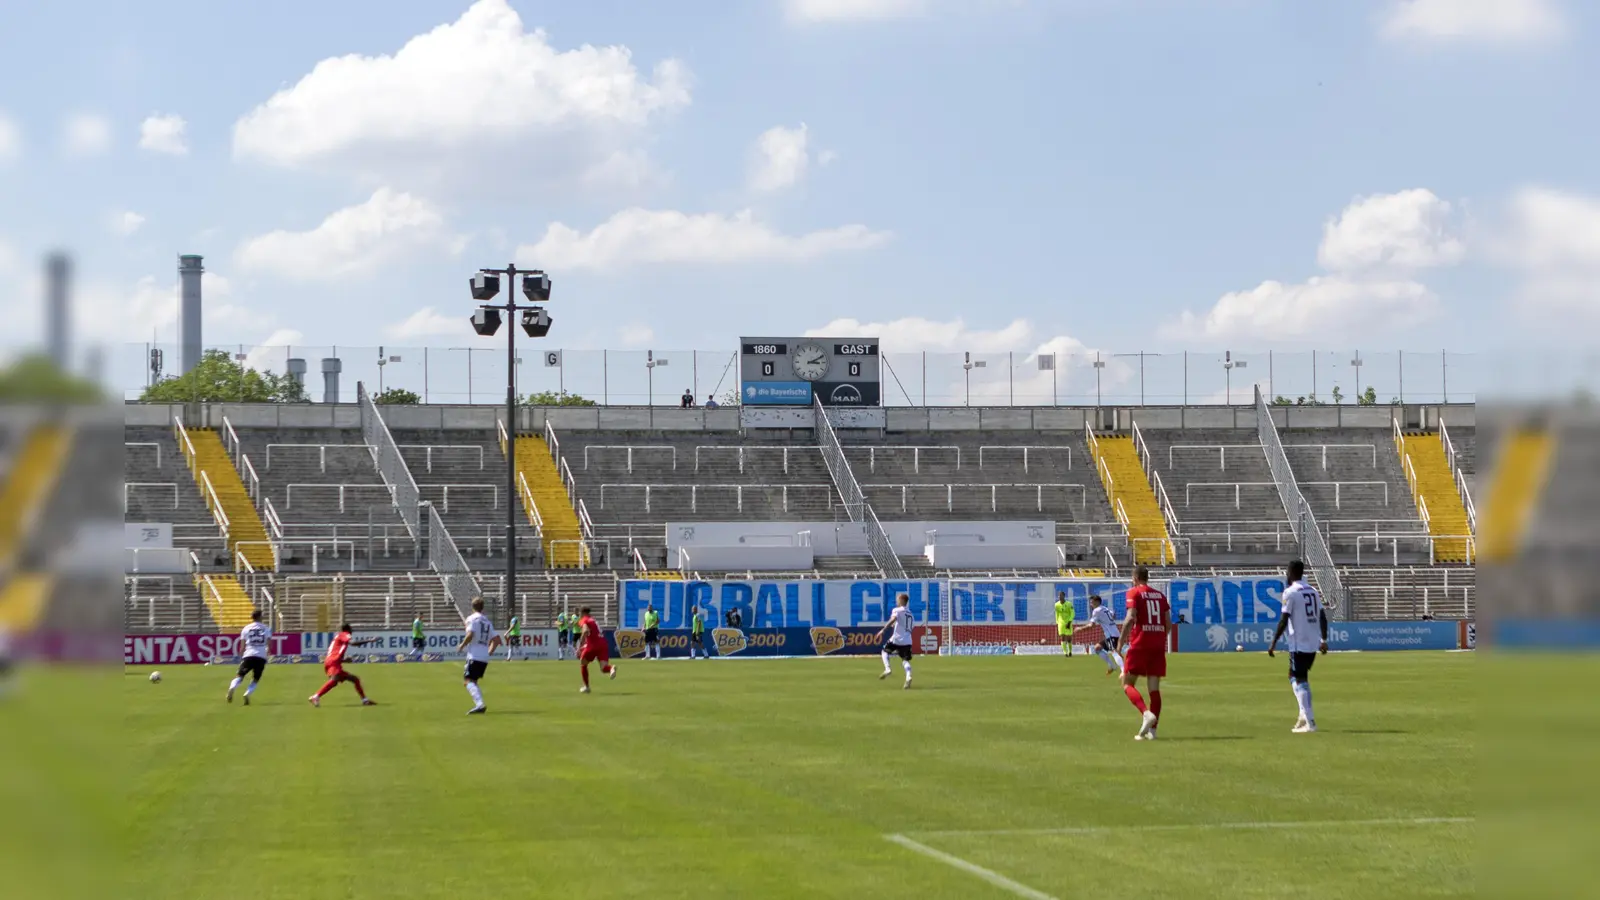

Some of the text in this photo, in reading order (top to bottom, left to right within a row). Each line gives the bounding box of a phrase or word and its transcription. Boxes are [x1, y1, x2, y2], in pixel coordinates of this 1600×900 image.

[753, 345, 777, 354] 1860
[841, 345, 871, 354] GAST
[548, 353, 557, 365] G
[764, 364, 771, 374] 0
[851, 364, 858, 375] 0
[758, 387, 807, 397] die Bayerische
[1170, 578, 1286, 623] FANS
[1302, 592, 1318, 617] 21
[1146, 599, 1161, 624] 14
[1234, 628, 1260, 643] die
[1394, 627, 1413, 635] nach
[1414, 627, 1432, 635] dem
[620, 635, 645, 649] Bet
[718, 633, 786, 647] Bet 3000
[816, 632, 882, 646] Bet 3000
[1367, 637, 1422, 646] Reinheitsgebot
